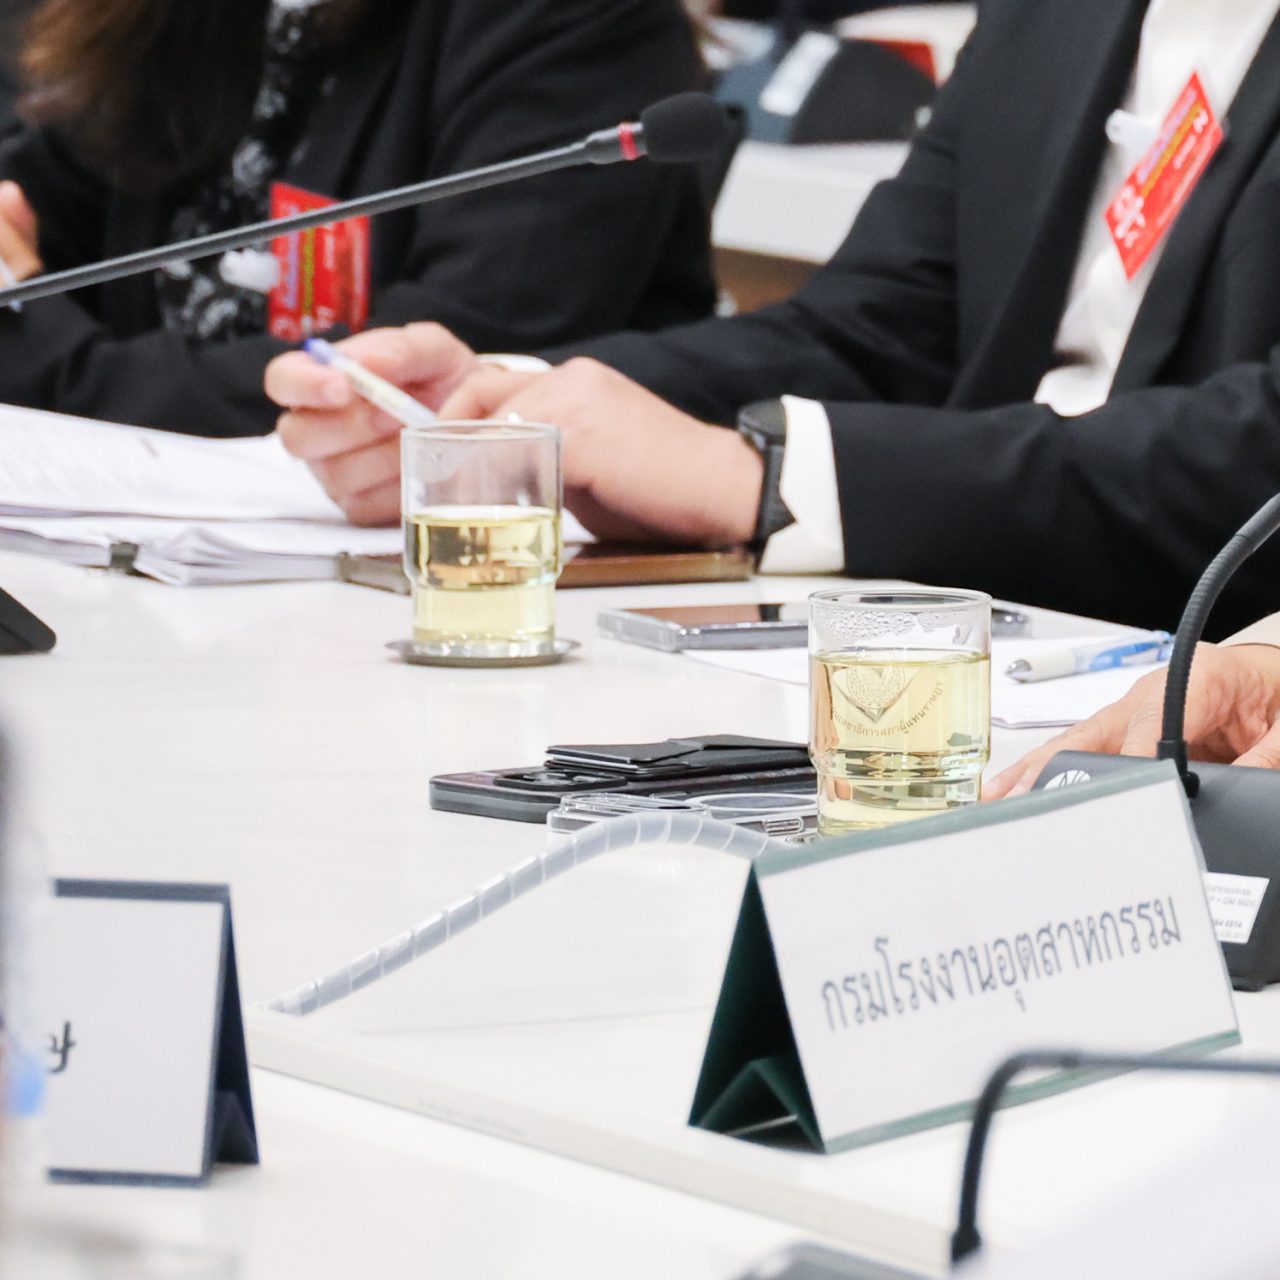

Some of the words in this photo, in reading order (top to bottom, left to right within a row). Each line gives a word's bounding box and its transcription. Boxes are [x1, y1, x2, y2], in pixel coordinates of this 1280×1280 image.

[820, 894, 1183, 1032] กรมโรงงานอุตสาหกรรม
